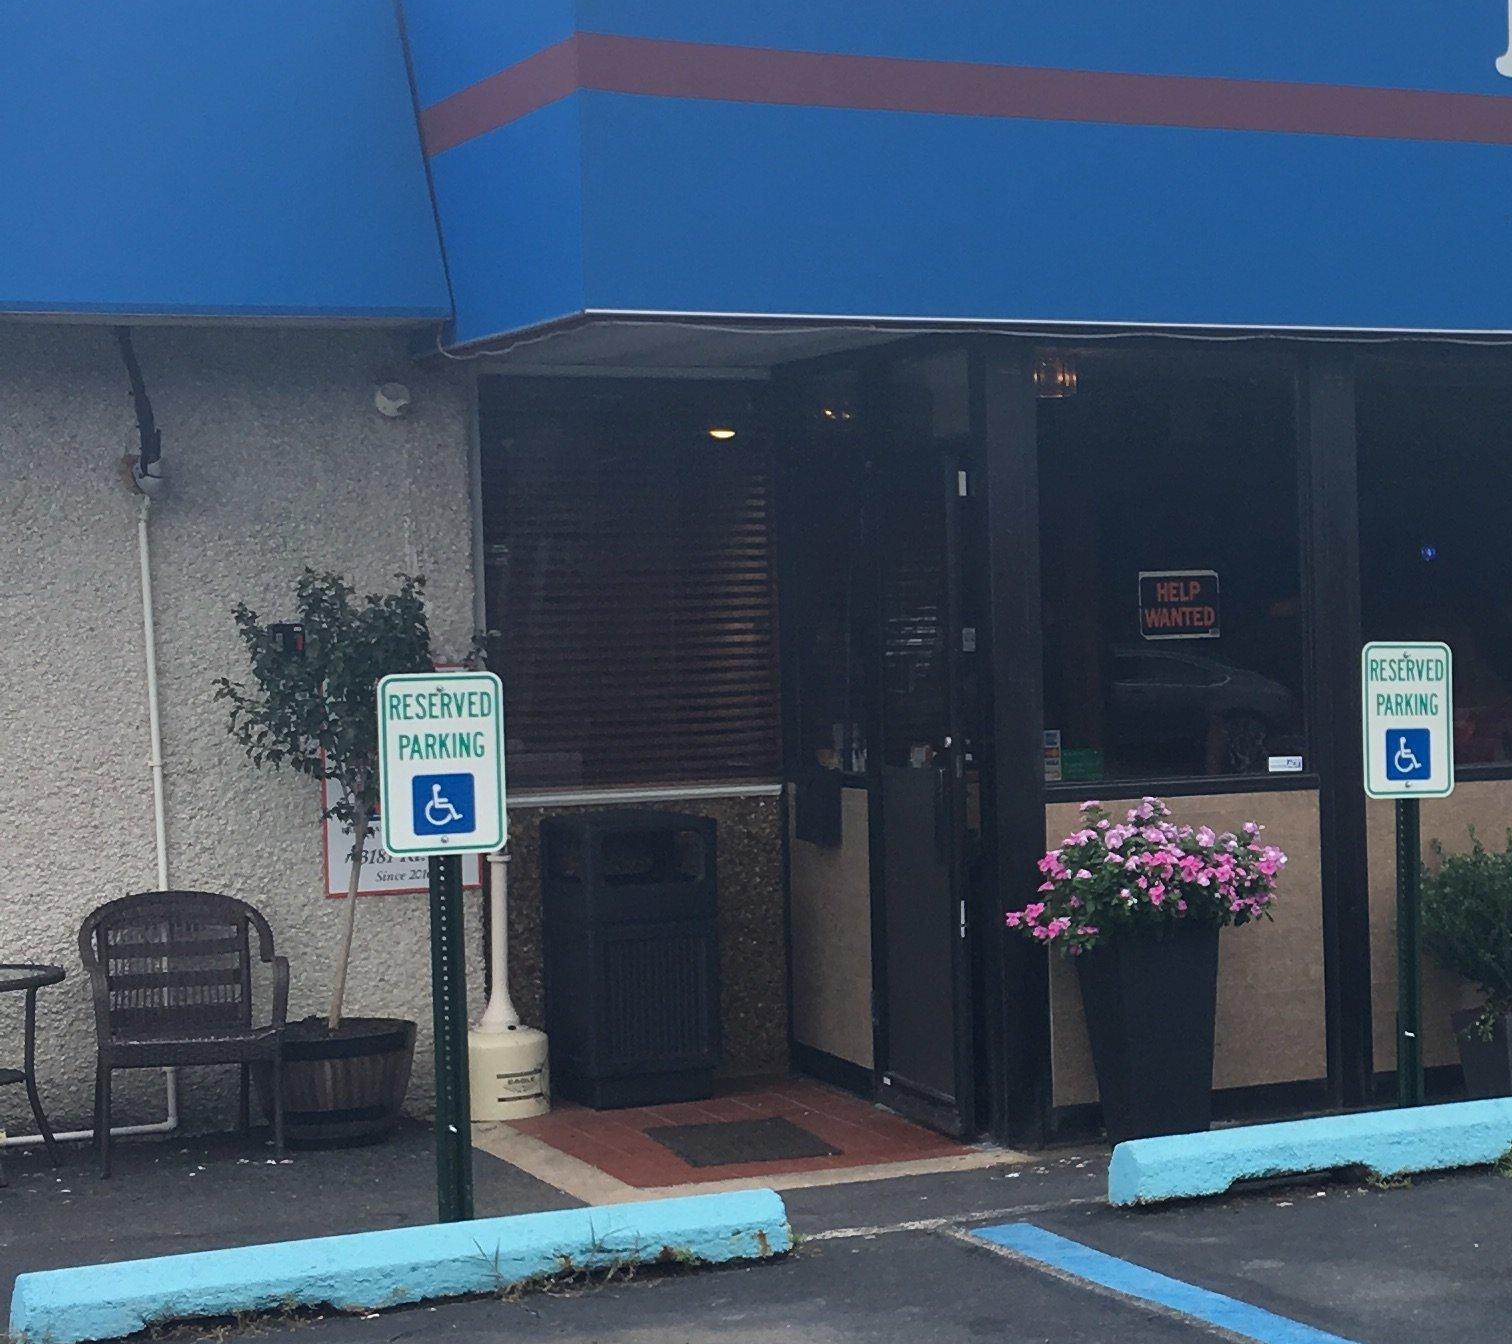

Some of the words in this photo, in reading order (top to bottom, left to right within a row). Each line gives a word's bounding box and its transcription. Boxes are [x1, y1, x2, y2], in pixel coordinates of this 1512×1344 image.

[1156, 581, 1201, 602] HELP
[1145, 606, 1215, 628] WANTED
[1371, 659, 1444, 682] RESERVED
[389, 691, 492, 720] RESERVED
[1377, 692, 1439, 716] PARKING
[399, 732, 485, 760] PARKING
[376, 871, 406, 882] Since
